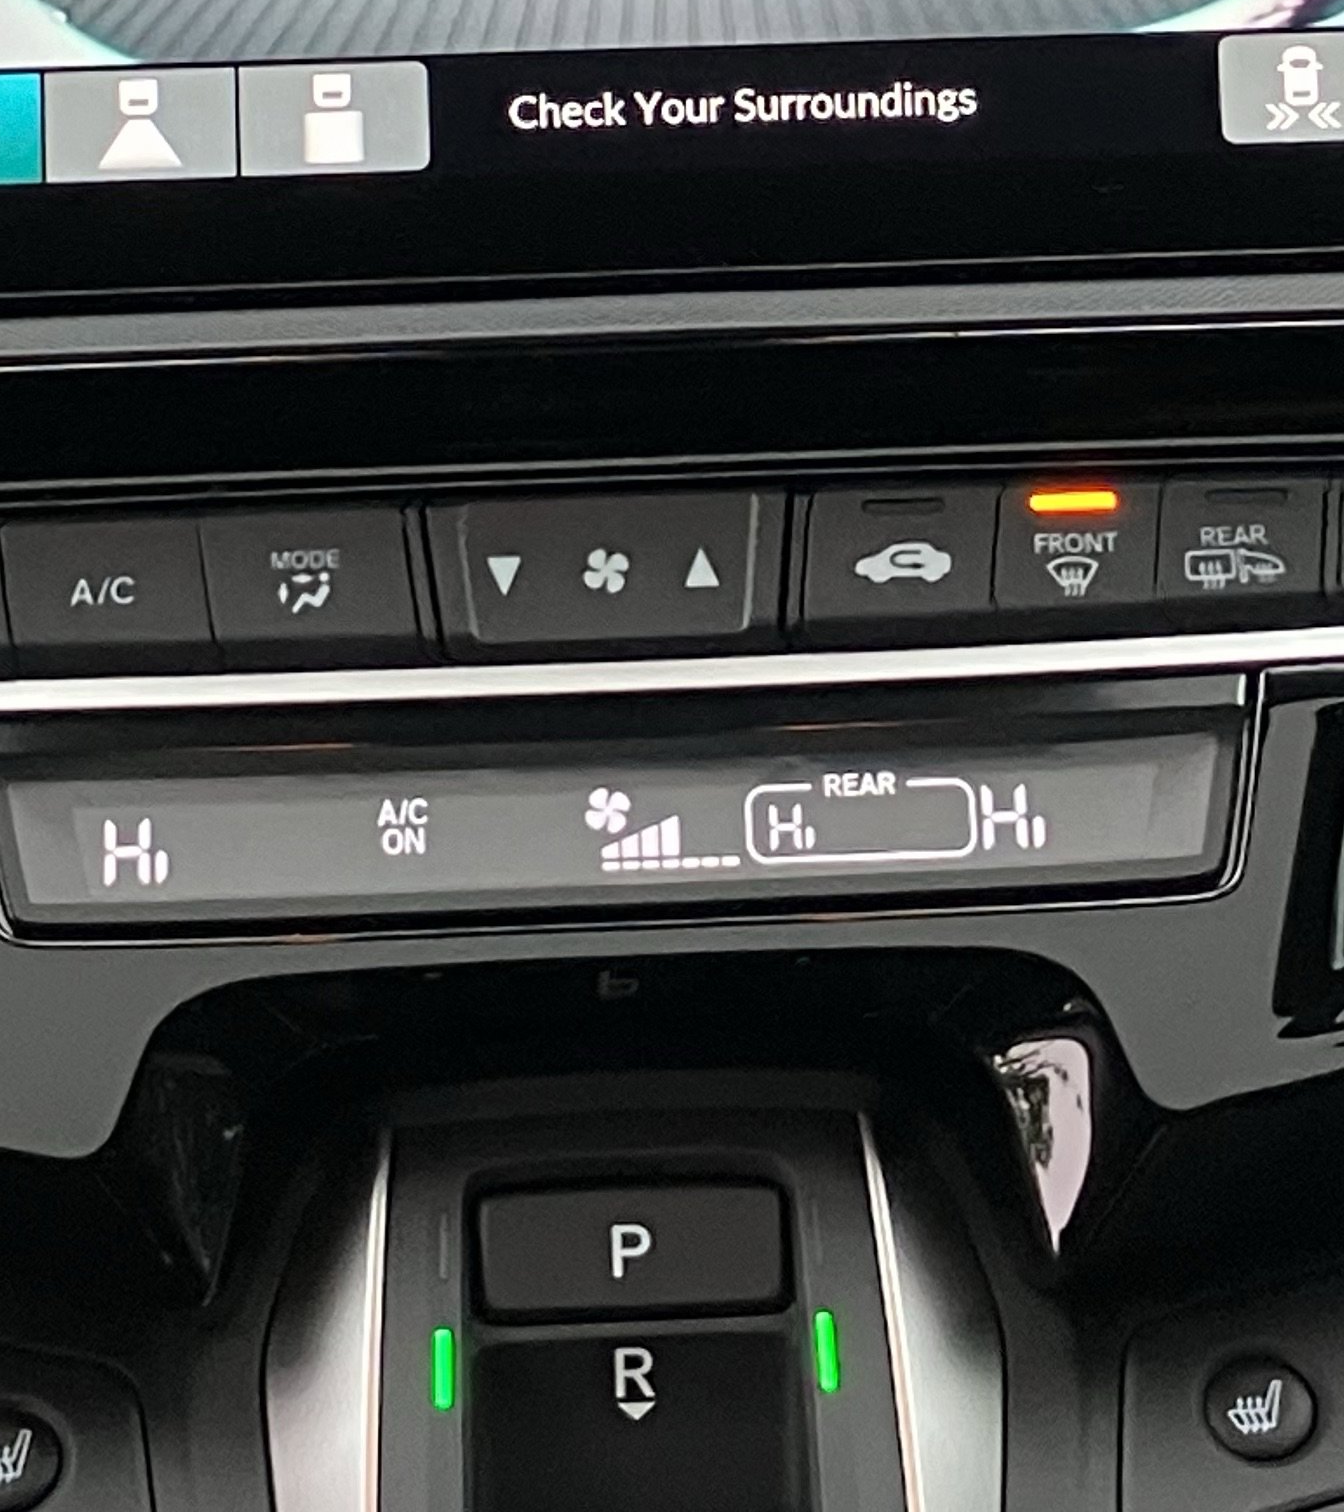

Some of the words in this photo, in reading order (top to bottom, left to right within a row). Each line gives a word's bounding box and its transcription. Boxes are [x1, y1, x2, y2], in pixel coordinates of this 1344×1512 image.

[508, 91, 627, 130] Check
[633, 90, 726, 126] Your
[733, 81, 978, 123] Surroundings
[1033, 531, 1118, 554] FRONT
[1200, 524, 1268, 547] REAR
[270, 548, 339, 570] MODE
[70, 576, 134, 606] A/C
[822, 771, 896, 798] REAR
[377, 797, 429, 829] A/C
[381, 824, 426, 856] ON
[611, 1224, 651, 1279] P
[614, 1347, 656, 1399] R
